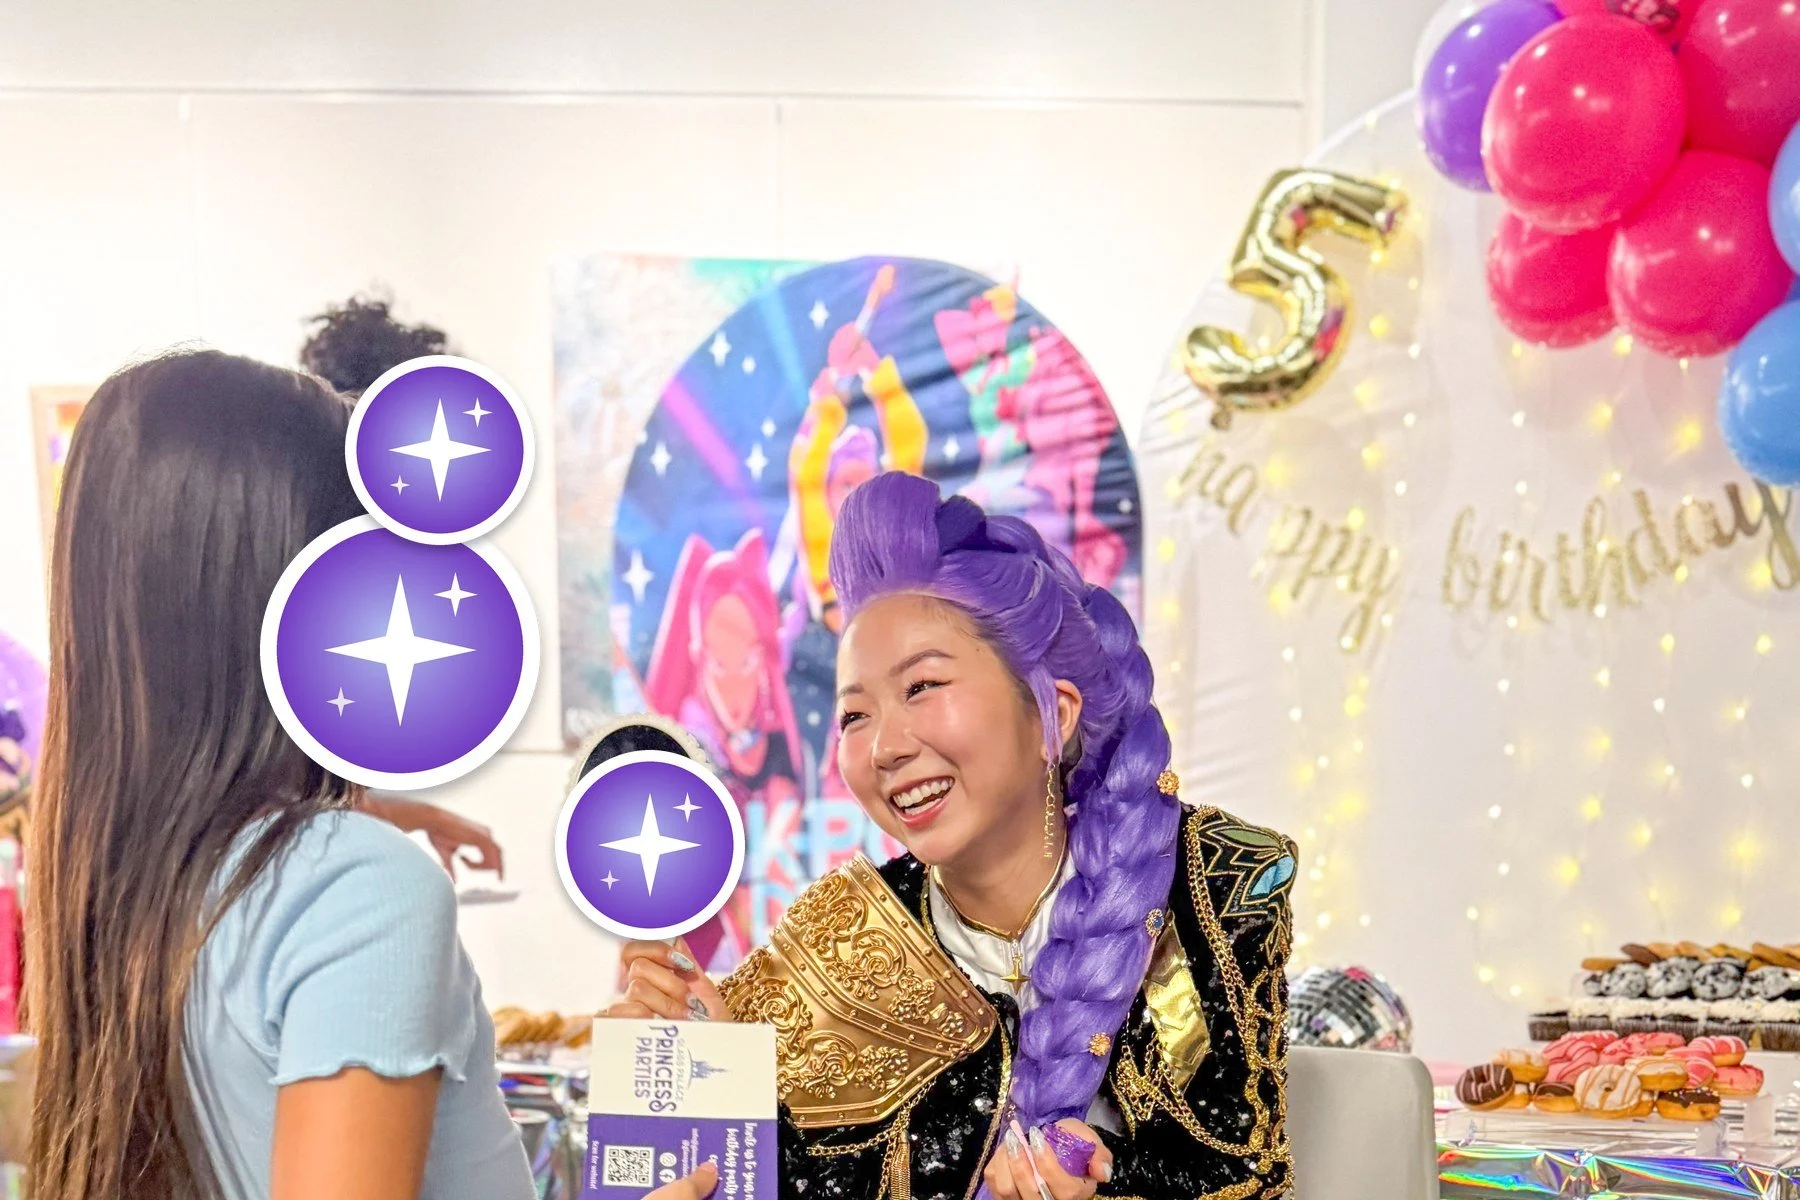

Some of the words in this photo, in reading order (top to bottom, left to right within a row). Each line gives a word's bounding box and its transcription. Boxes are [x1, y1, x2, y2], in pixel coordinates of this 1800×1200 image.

[1184, 168, 1410, 412] 5
[1441, 478, 1800, 622] birthday
[634, 1037, 653, 1098] PARTIES
[648, 1025, 679, 1112] PRINCESS
[723, 1128, 739, 1168] birthday
[723, 1169, 739, 1195] party
